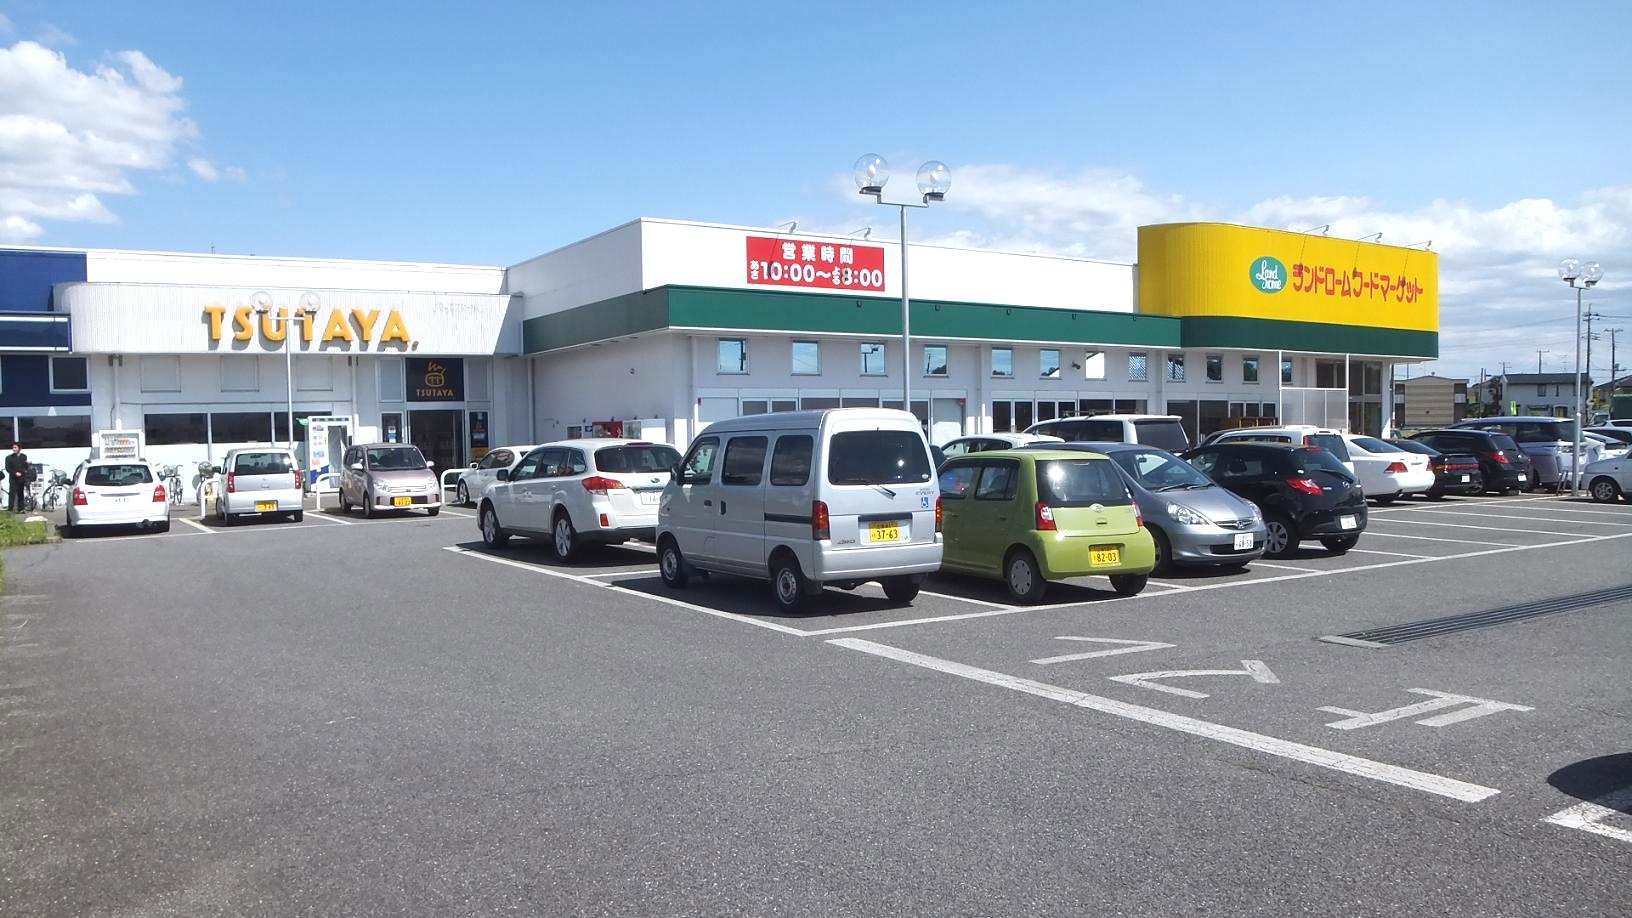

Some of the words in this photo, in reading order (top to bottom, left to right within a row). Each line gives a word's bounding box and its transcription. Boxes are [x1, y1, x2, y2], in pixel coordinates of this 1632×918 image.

[782, 242, 854, 264] 営業時間
[204, 304, 412, 342] TSUTAYA
[416, 388, 454, 397] TSUTAYA
[876, 529, 898, 540] 37-63
